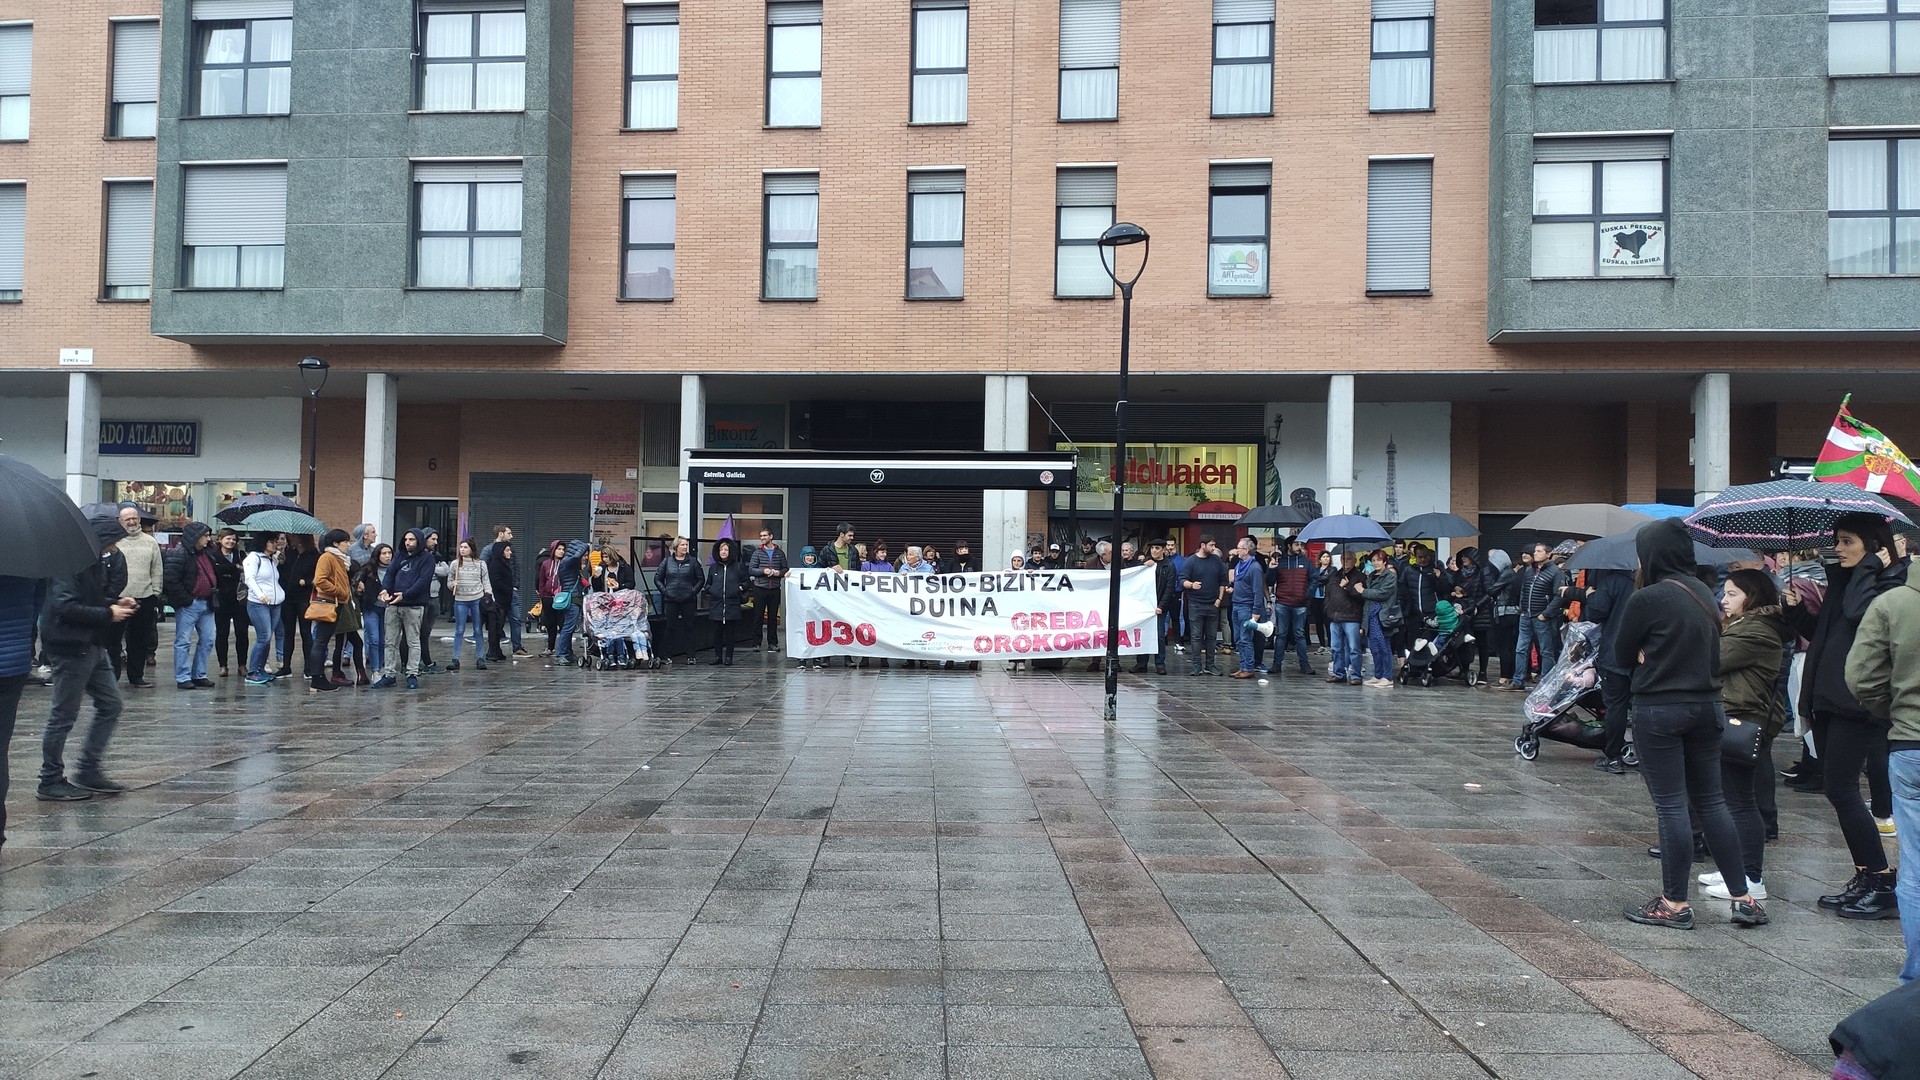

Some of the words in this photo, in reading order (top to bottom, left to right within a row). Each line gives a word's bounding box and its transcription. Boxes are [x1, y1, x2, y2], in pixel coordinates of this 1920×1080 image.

[1601, 225, 1628, 233] EUSKAL
[128, 424, 192, 445] ATLANTICO
[428, 457, 437, 471] 6
[799, 572, 1074, 594] LAN-PENTSIO-BIZITZA
[909, 597, 998, 617] DUINA
[1010, 610, 1103, 631] GREBA
[805, 620, 877, 646] U30
[973, 629, 1142, 653] OROKORRA!
